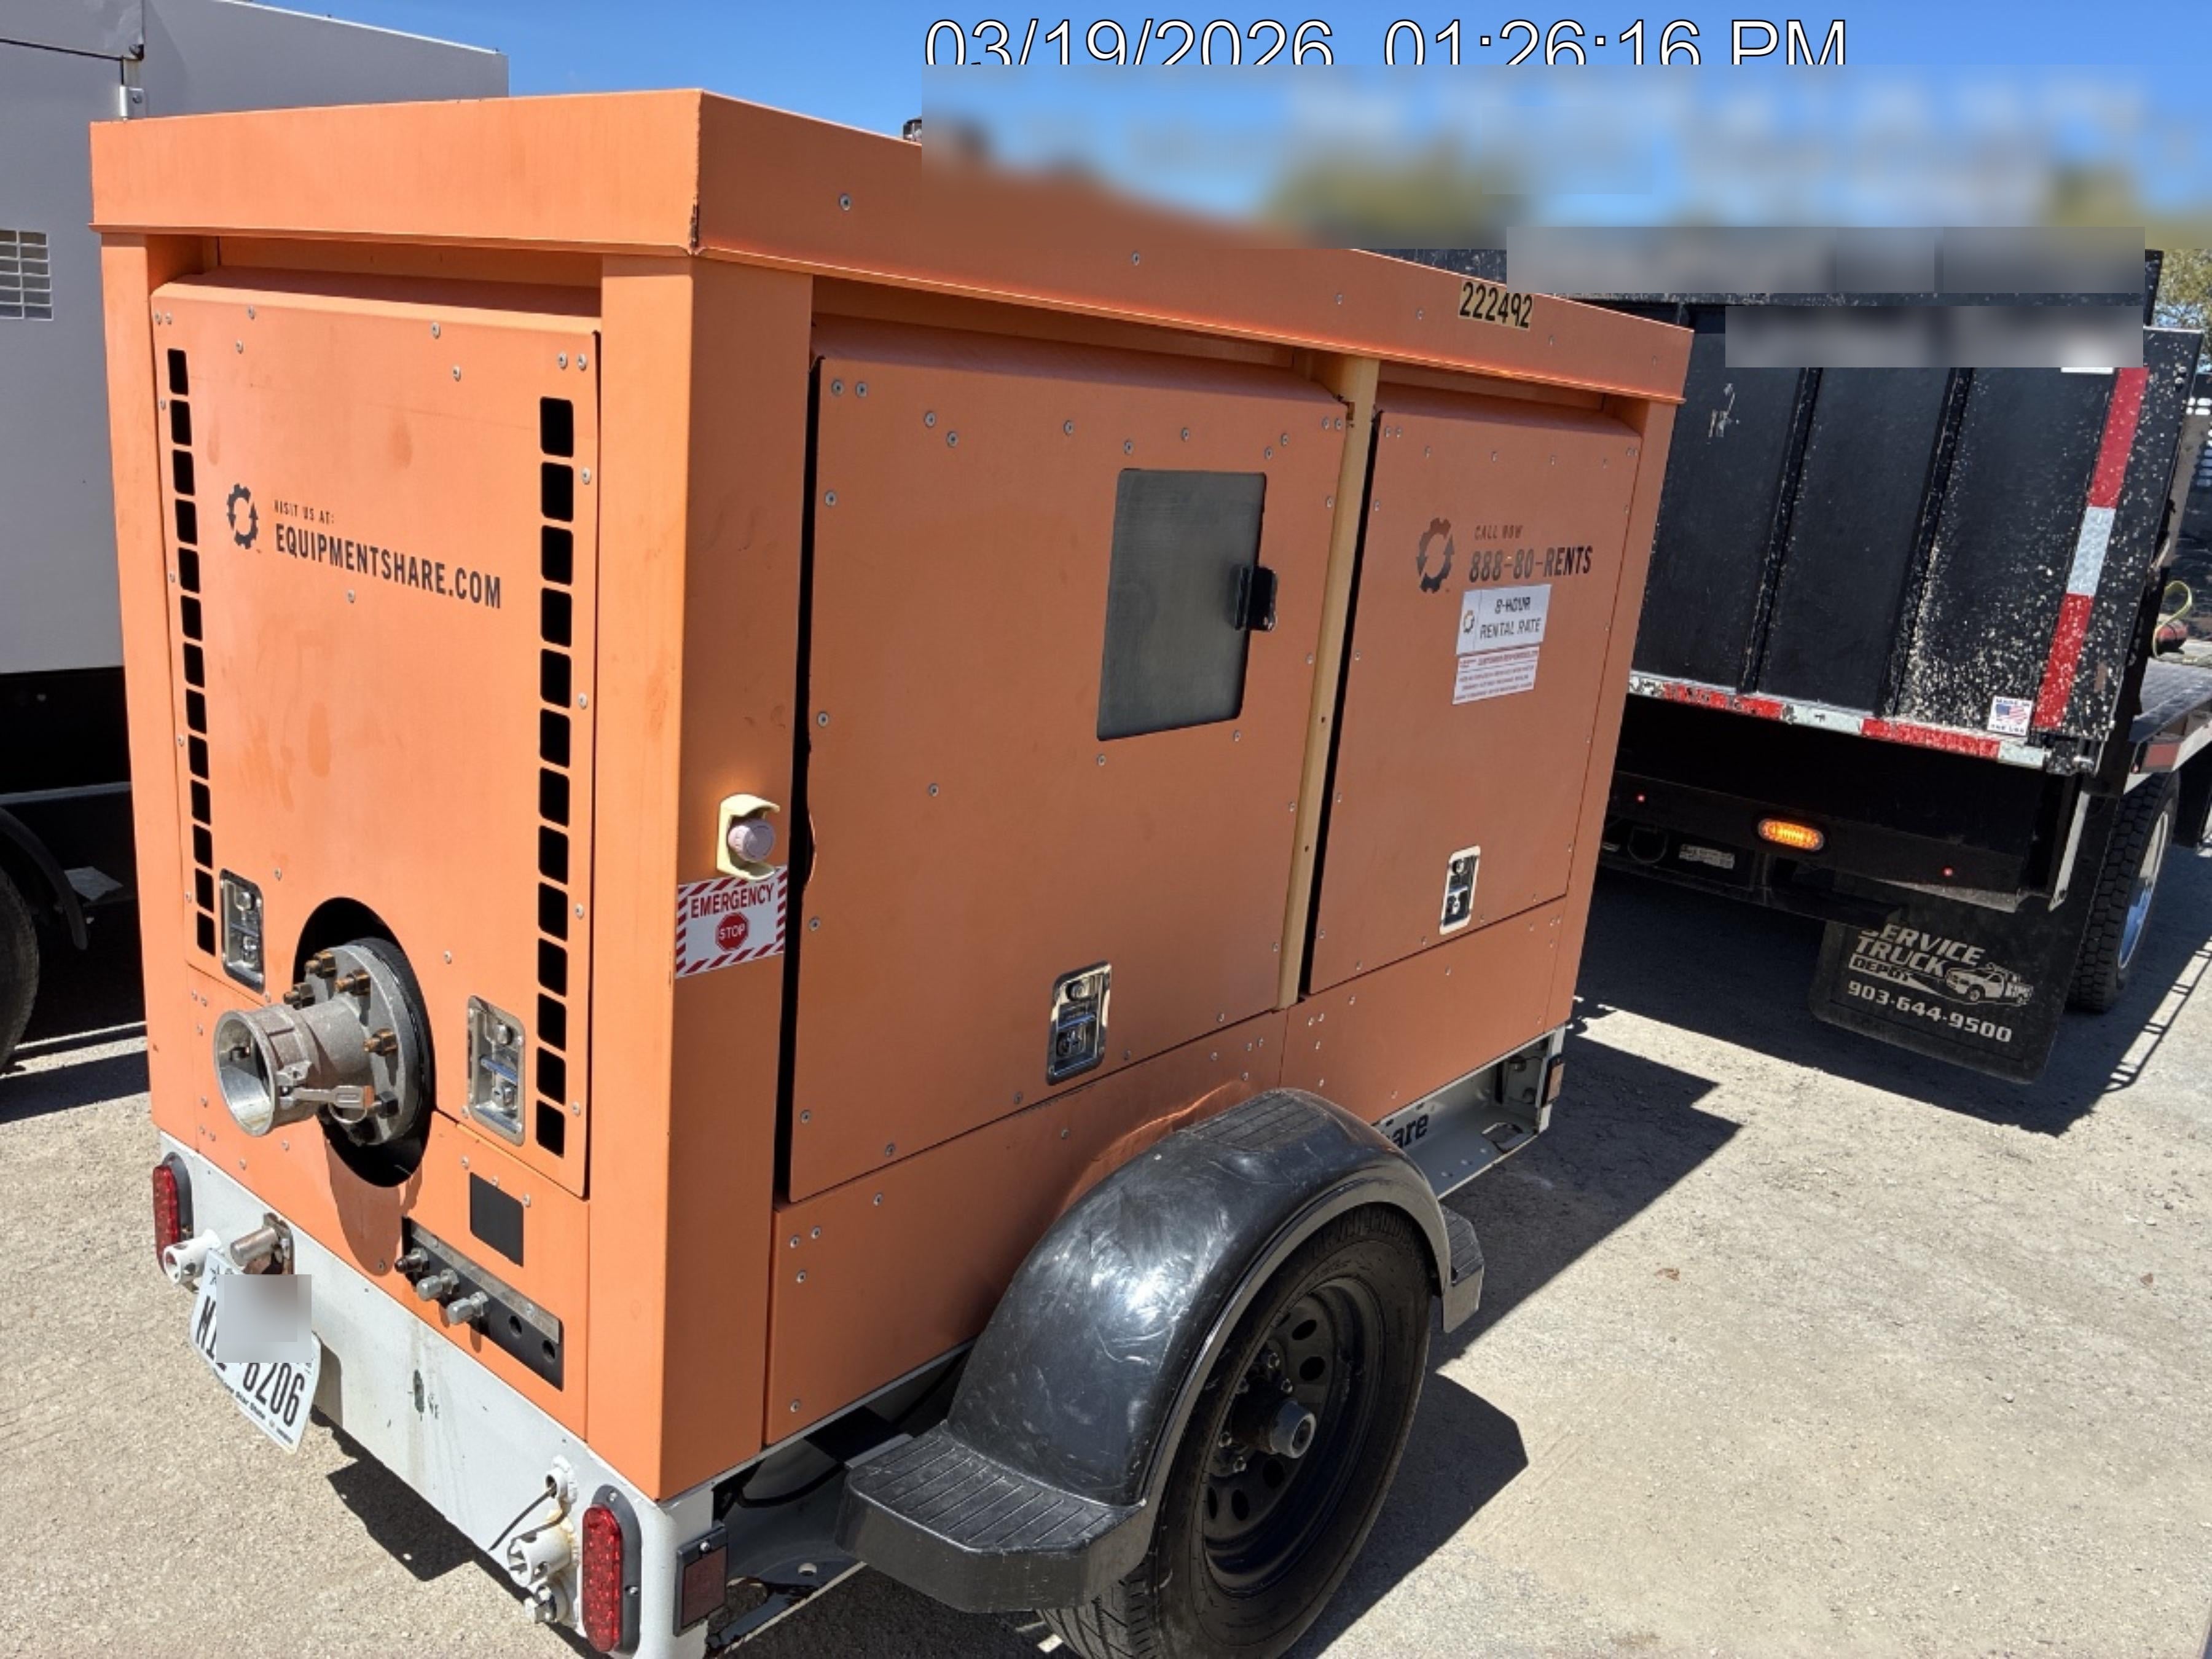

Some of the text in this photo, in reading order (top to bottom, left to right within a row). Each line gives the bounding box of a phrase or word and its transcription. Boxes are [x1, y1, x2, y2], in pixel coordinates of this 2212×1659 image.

[1459, 281, 1532, 328] 222492
[302, 506, 314, 522] US
[1475, 525, 1497, 540] CALL
[276, 523, 501, 609] EQUIPMENTSHARE.COM
[1469, 546, 1593, 582] 888-80-RENTS
[1495, 597, 1531, 614] 8-HOUR
[1480, 618, 1541, 640] RENTAL RATE
[691, 883, 775, 919] EMERGENCY
[719, 923, 746, 940] STOP
[1856, 935, 1949, 978] TRUCK
[1381, 1113, 1429, 1148] are
